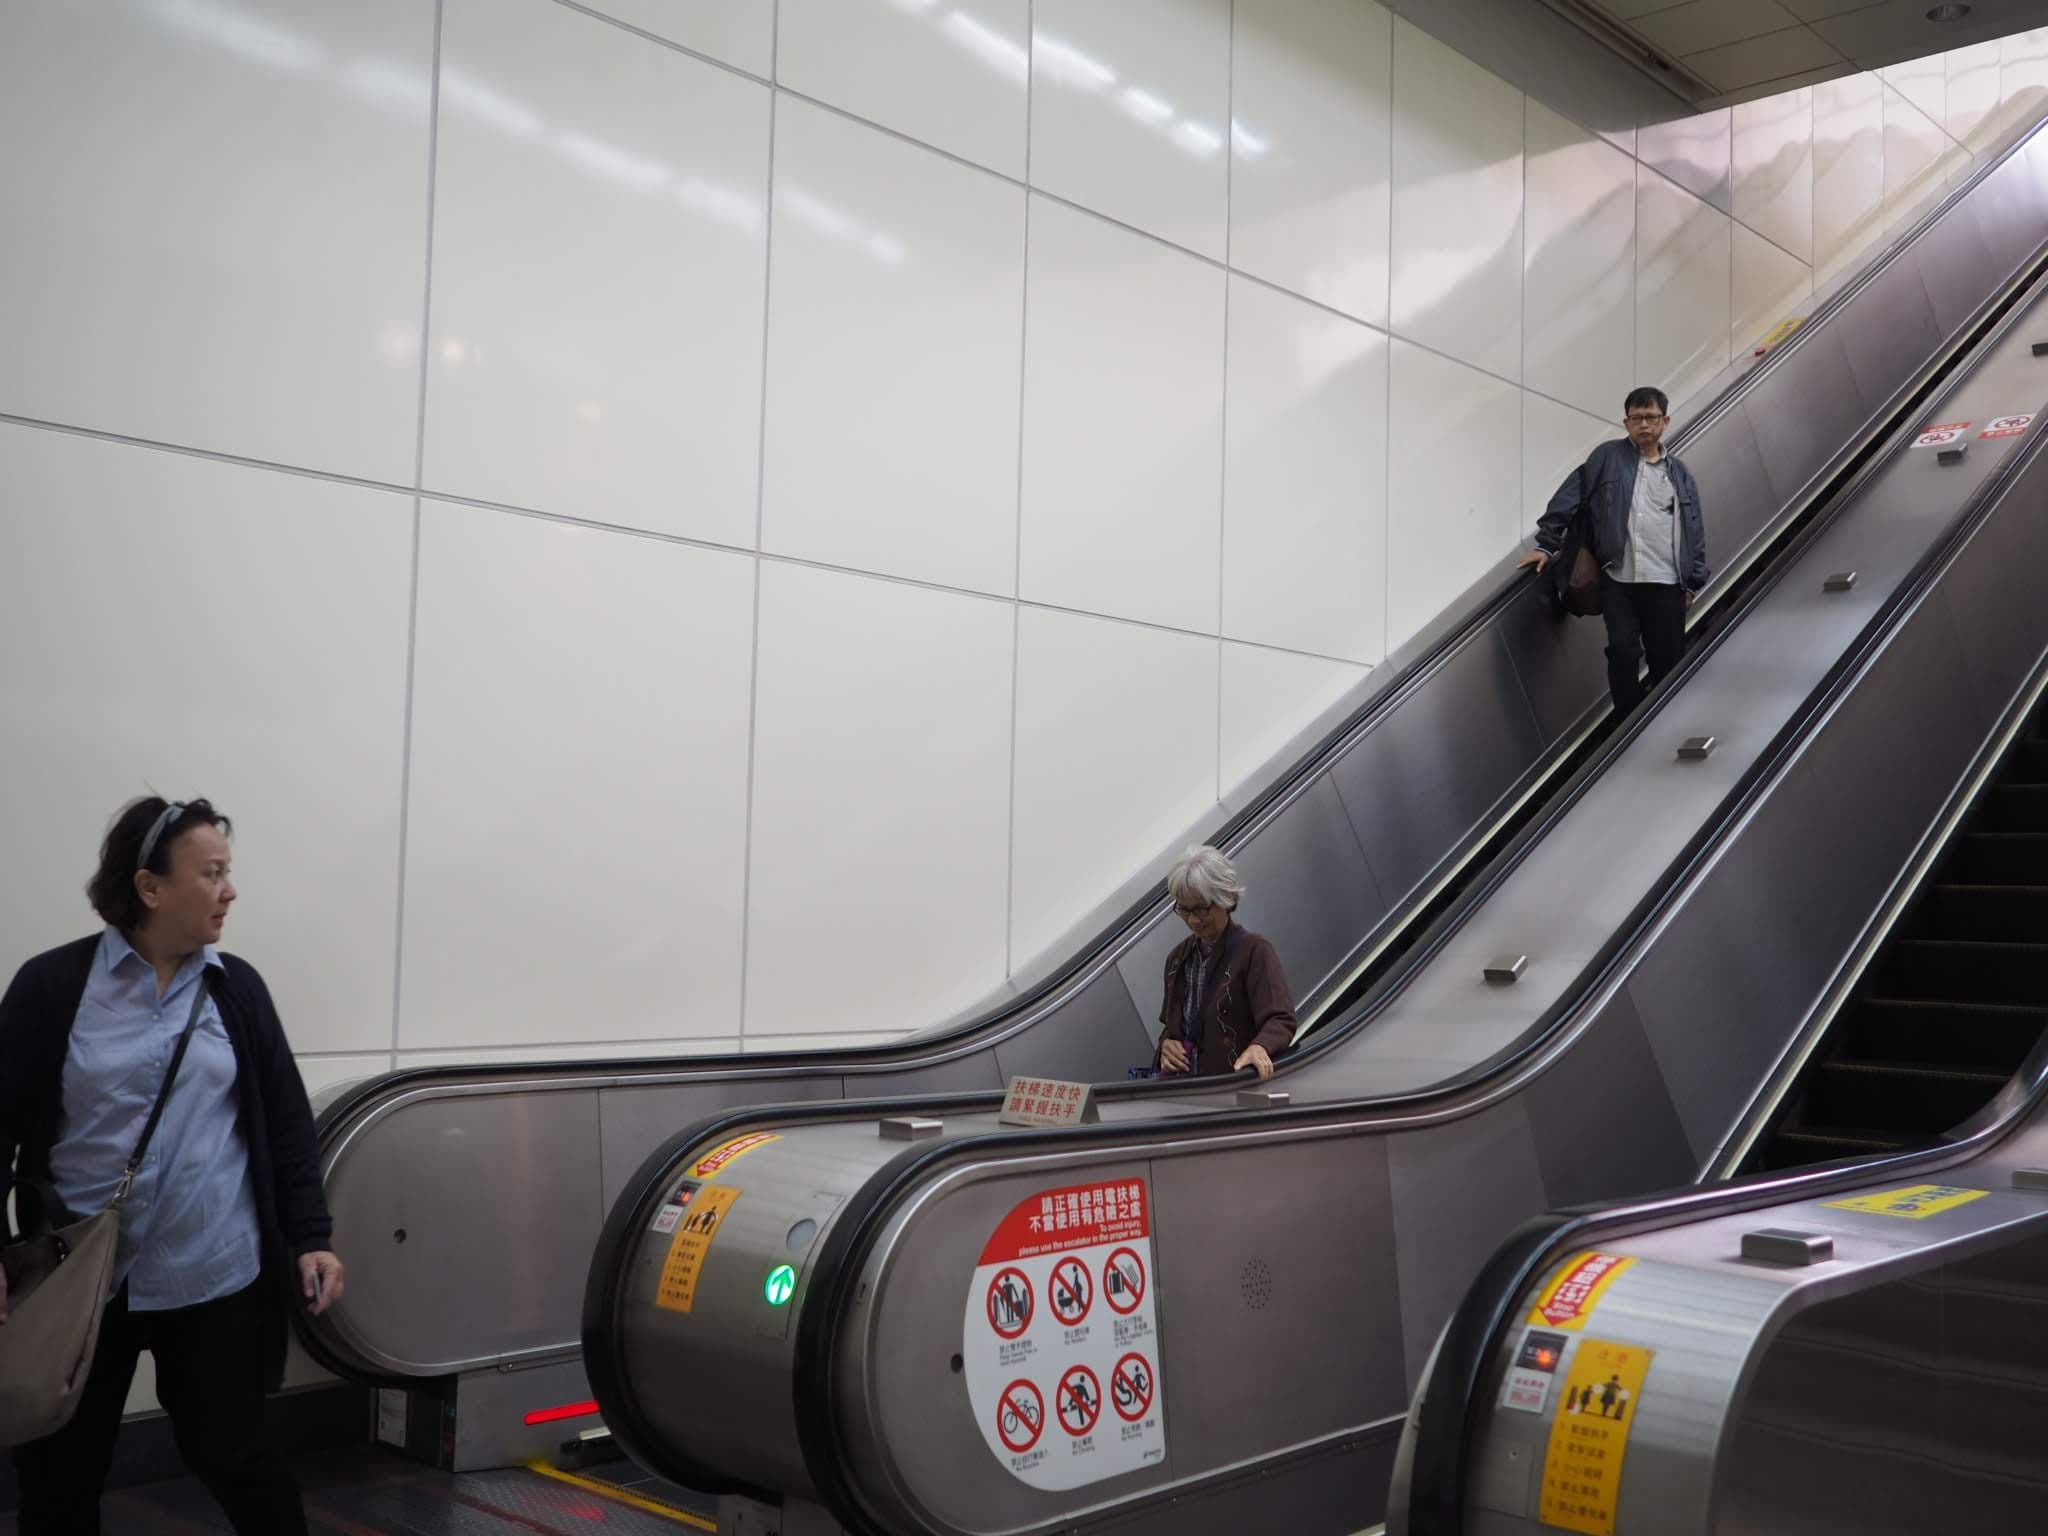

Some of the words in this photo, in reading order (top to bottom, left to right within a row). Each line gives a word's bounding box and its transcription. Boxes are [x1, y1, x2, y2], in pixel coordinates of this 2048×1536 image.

[1015, 1081, 1081, 1101] 扶梯速度快
[1009, 1097, 1076, 1118] 請緊握扶手
[1041, 1184, 1140, 1215] 請正確使用電扶梯
[1019, 1245, 1040, 1257] please
[1040, 1243, 1052, 1252] use
[1053, 1240, 1063, 1249] the
[1064, 1236, 1092, 1248] escalator
[1099, 1233, 1108, 1242] the
[1109, 1231, 1129, 1242] proper
